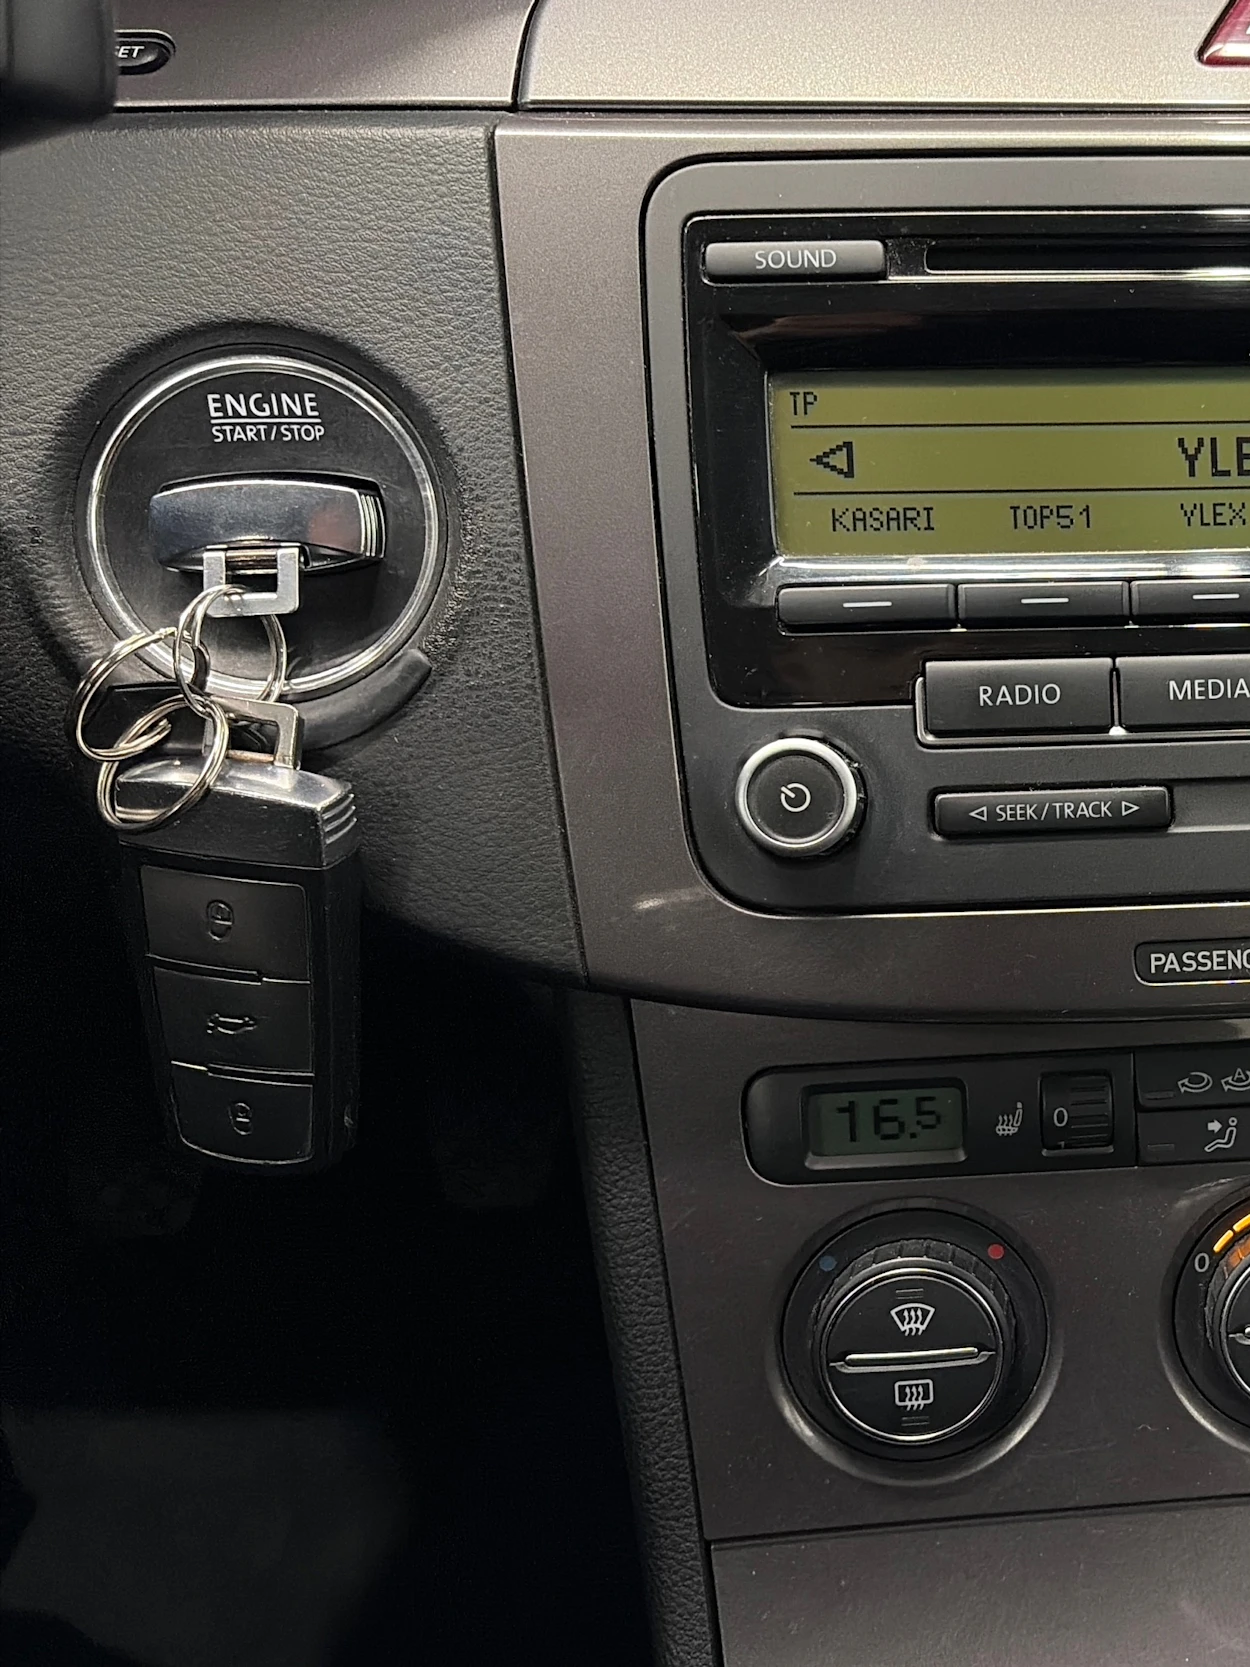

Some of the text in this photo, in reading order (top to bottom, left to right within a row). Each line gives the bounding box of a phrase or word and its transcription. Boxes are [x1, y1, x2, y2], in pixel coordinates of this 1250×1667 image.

[754, 248, 837, 270] SOUND
[206, 393, 320, 418] ENGINE
[789, 391, 818, 416] TP
[831, 506, 935, 533] KASARI
[1009, 505, 1092, 530] TOP51
[1180, 502, 1247, 527] YLEX
[978, 683, 1062, 707] RADIO
[1168, 679, 1250, 702] MEDIA
